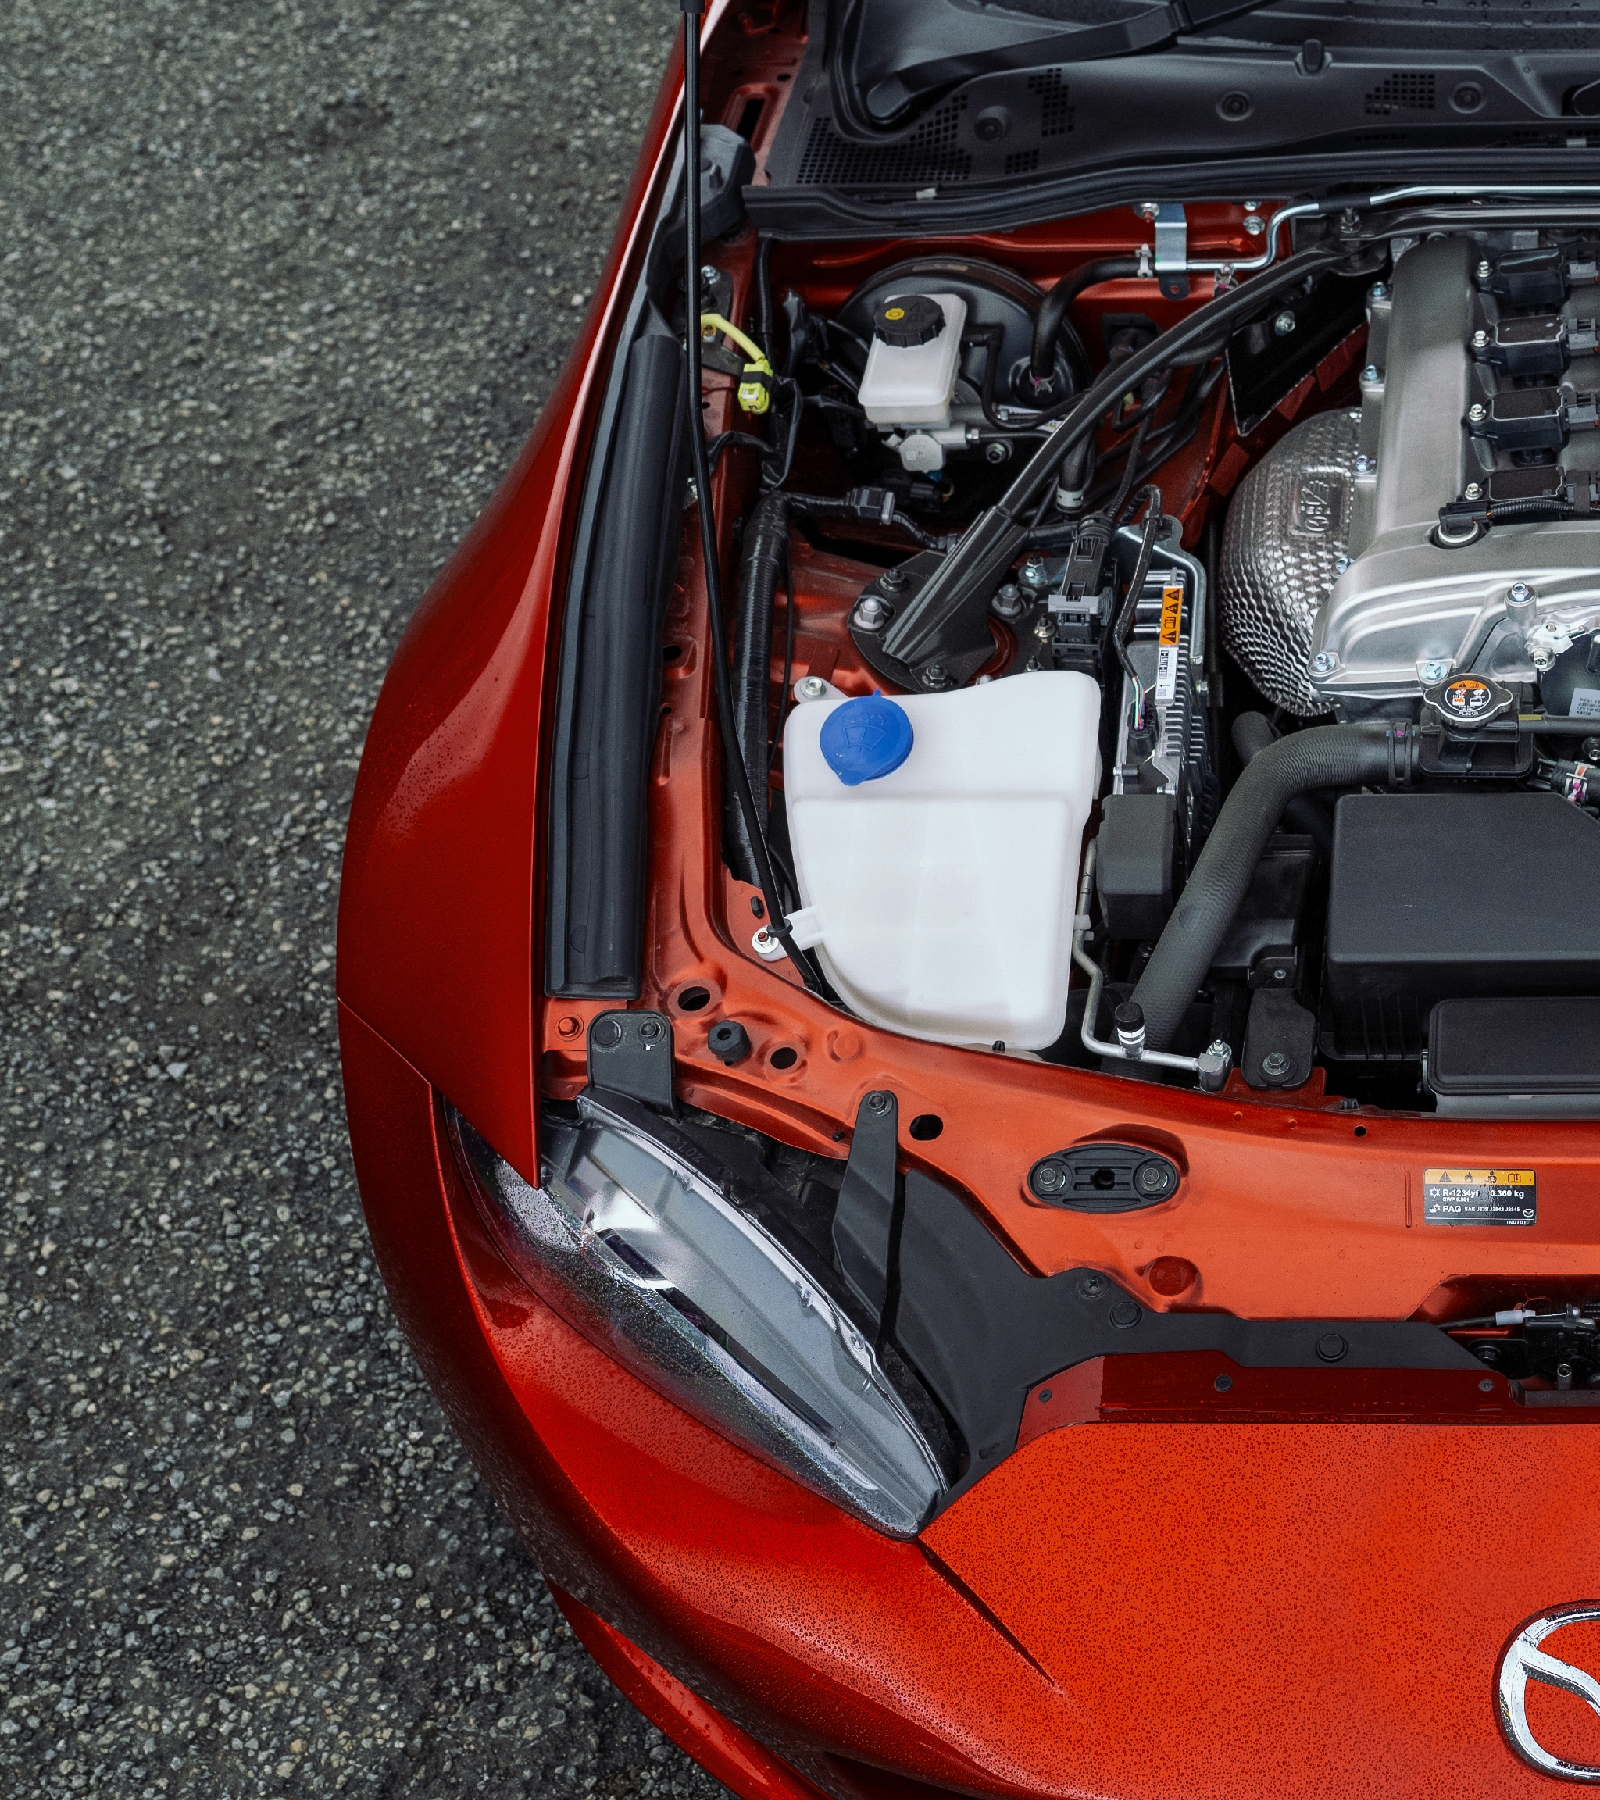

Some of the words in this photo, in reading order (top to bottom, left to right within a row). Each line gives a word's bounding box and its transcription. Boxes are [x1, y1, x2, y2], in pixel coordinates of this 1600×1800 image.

[1442, 1188, 1480, 1199] R-1234yf
[1513, 1189, 1525, 1200] kg
[1442, 1205, 1462, 1213] PAG
